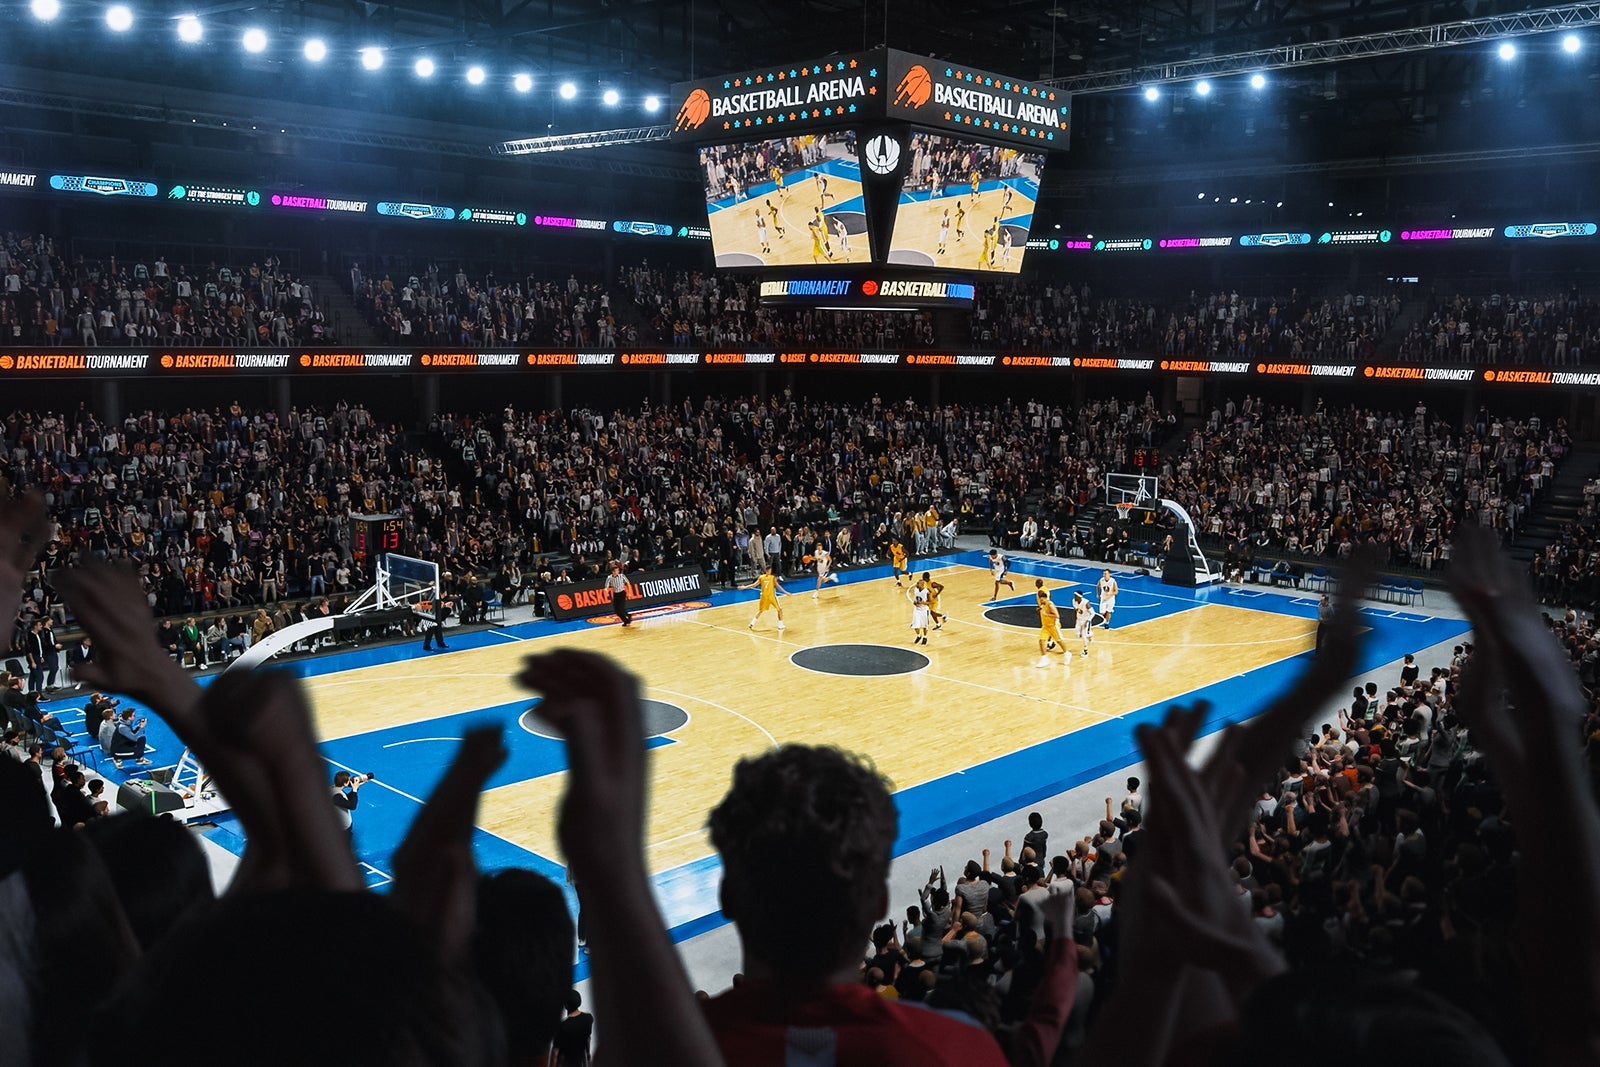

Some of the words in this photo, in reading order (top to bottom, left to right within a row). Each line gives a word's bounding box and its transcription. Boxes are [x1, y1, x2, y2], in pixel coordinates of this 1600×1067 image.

[712, 87, 804, 117] BASKETBALL
[806, 76, 866, 104] ARENA
[934, 82, 1015, 118] BASKETBALL
[1016, 103, 1060, 128] ARENA
[383, 520, 404, 531] 1:54
[383, 532, 399, 549] 13
[574, 574, 701, 609] BASKETALLTOURNAMENT
